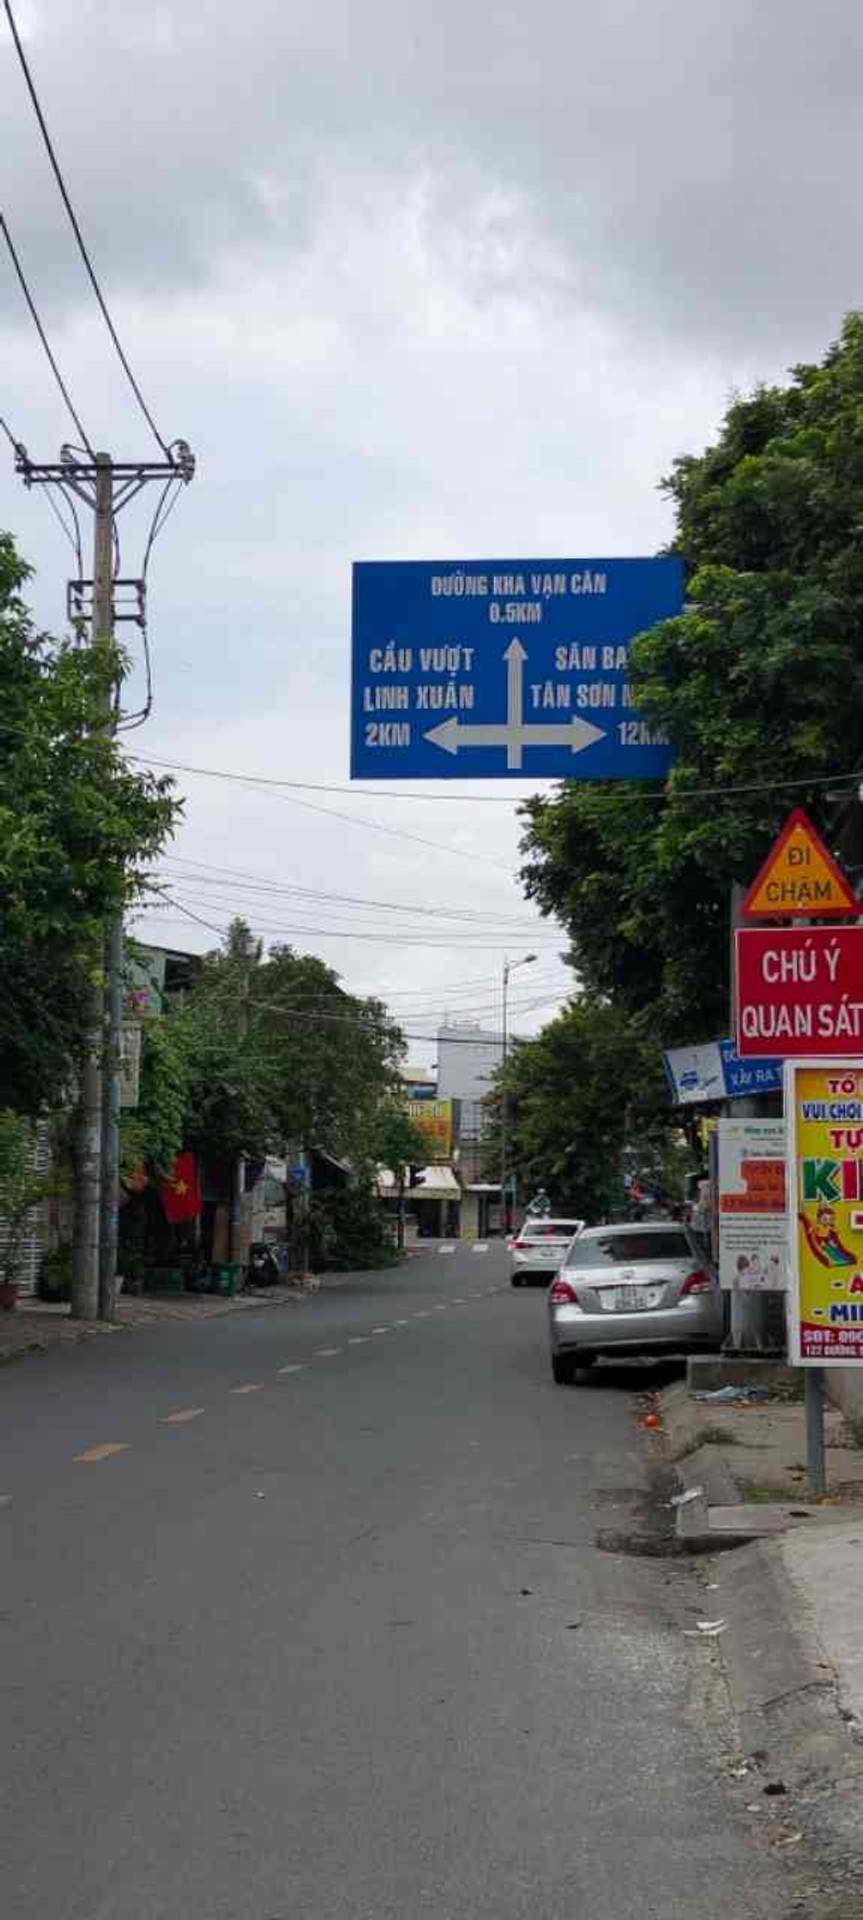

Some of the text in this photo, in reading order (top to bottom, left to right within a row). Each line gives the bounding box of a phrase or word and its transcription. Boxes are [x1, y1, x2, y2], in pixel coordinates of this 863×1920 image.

[493, 575, 525, 596] KHA
[531, 573, 566, 600] VẠN
[488, 601, 541, 624] 0.5KM
[420, 643, 475, 678] VƯỢT
[555, 641, 596, 671] SÂN
[363, 681, 475, 712] LINH XUÂN
[530, 679, 571, 708] TÂN
[576, 679, 615, 708] SƠN
[364, 721, 411, 747] 2KM
[787, 846, 811, 866] ĐI
[762, 937, 841, 984] CHÚ Ý
[742, 994, 863, 1038] QUAN SÁT
[802, 1103, 826, 1119] VUI
